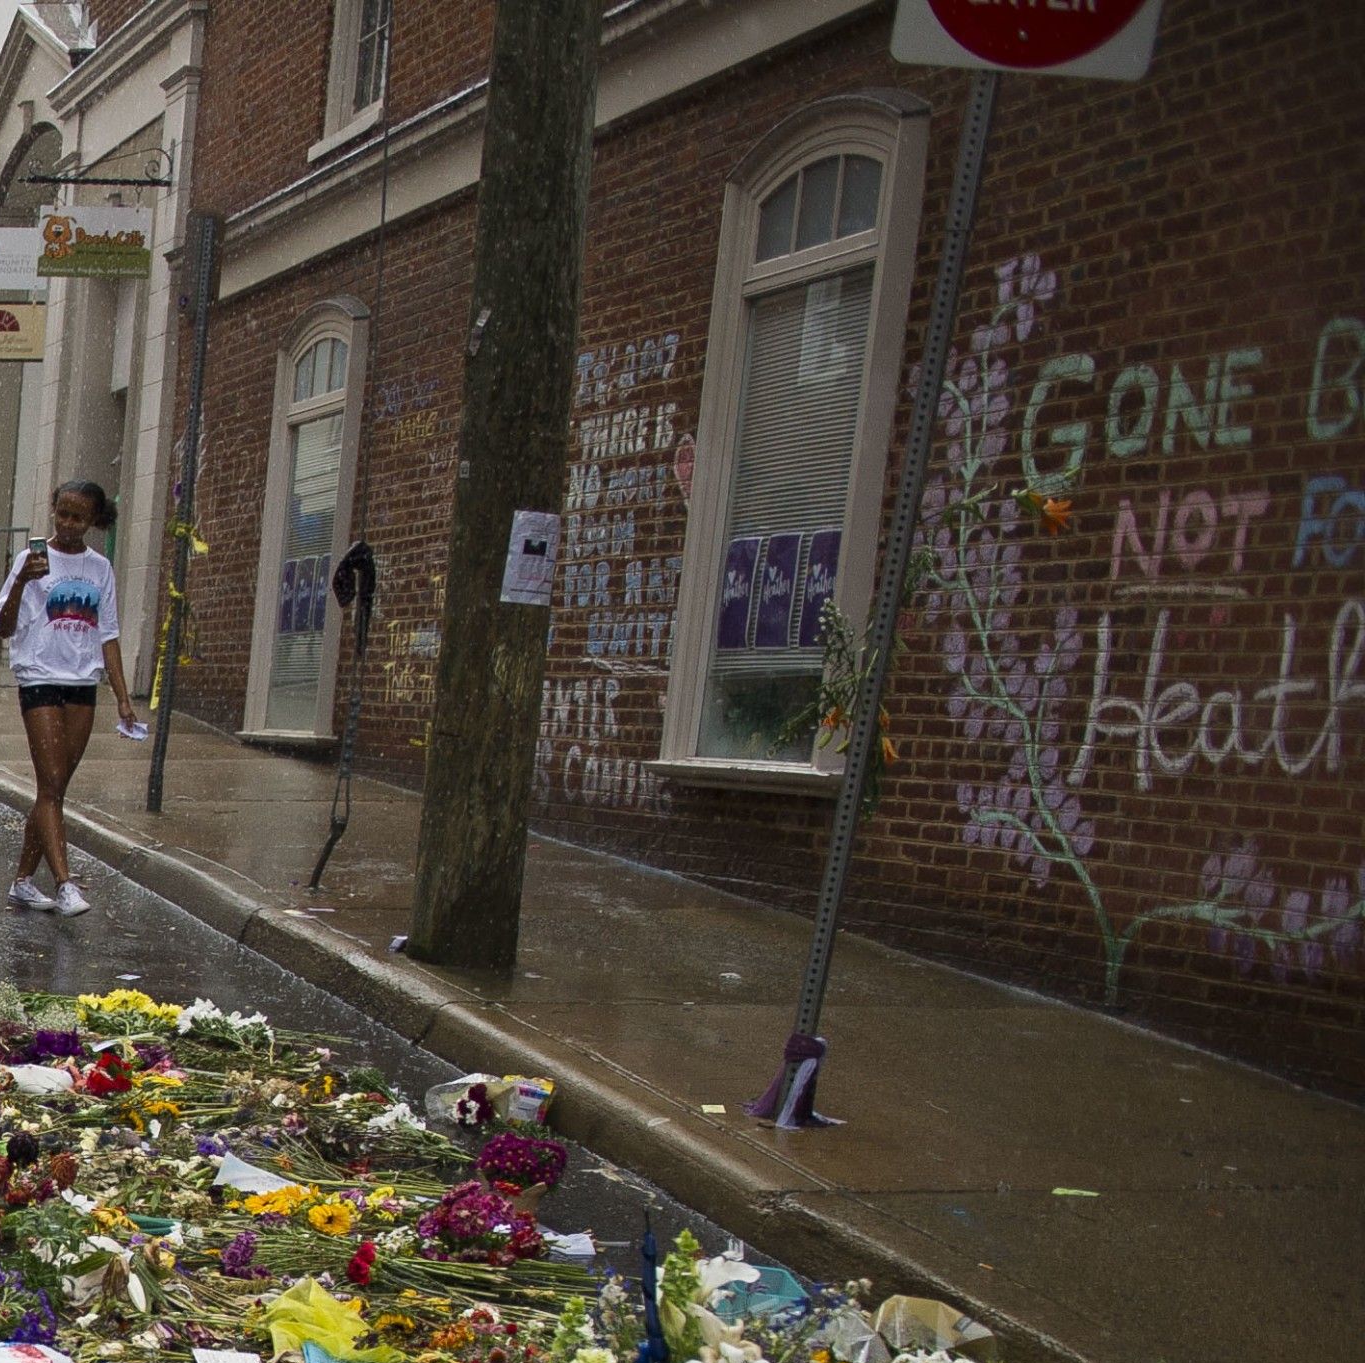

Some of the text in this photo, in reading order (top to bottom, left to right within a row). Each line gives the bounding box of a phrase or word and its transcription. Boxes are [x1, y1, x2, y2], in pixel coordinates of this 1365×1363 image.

[580, 401, 680, 457] THERE IS
[1022, 347, 1264, 492] GONE
[563, 462, 598, 509] NO
[1112, 490, 1270, 582] NOT
[562, 562, 610, 608] FOR
